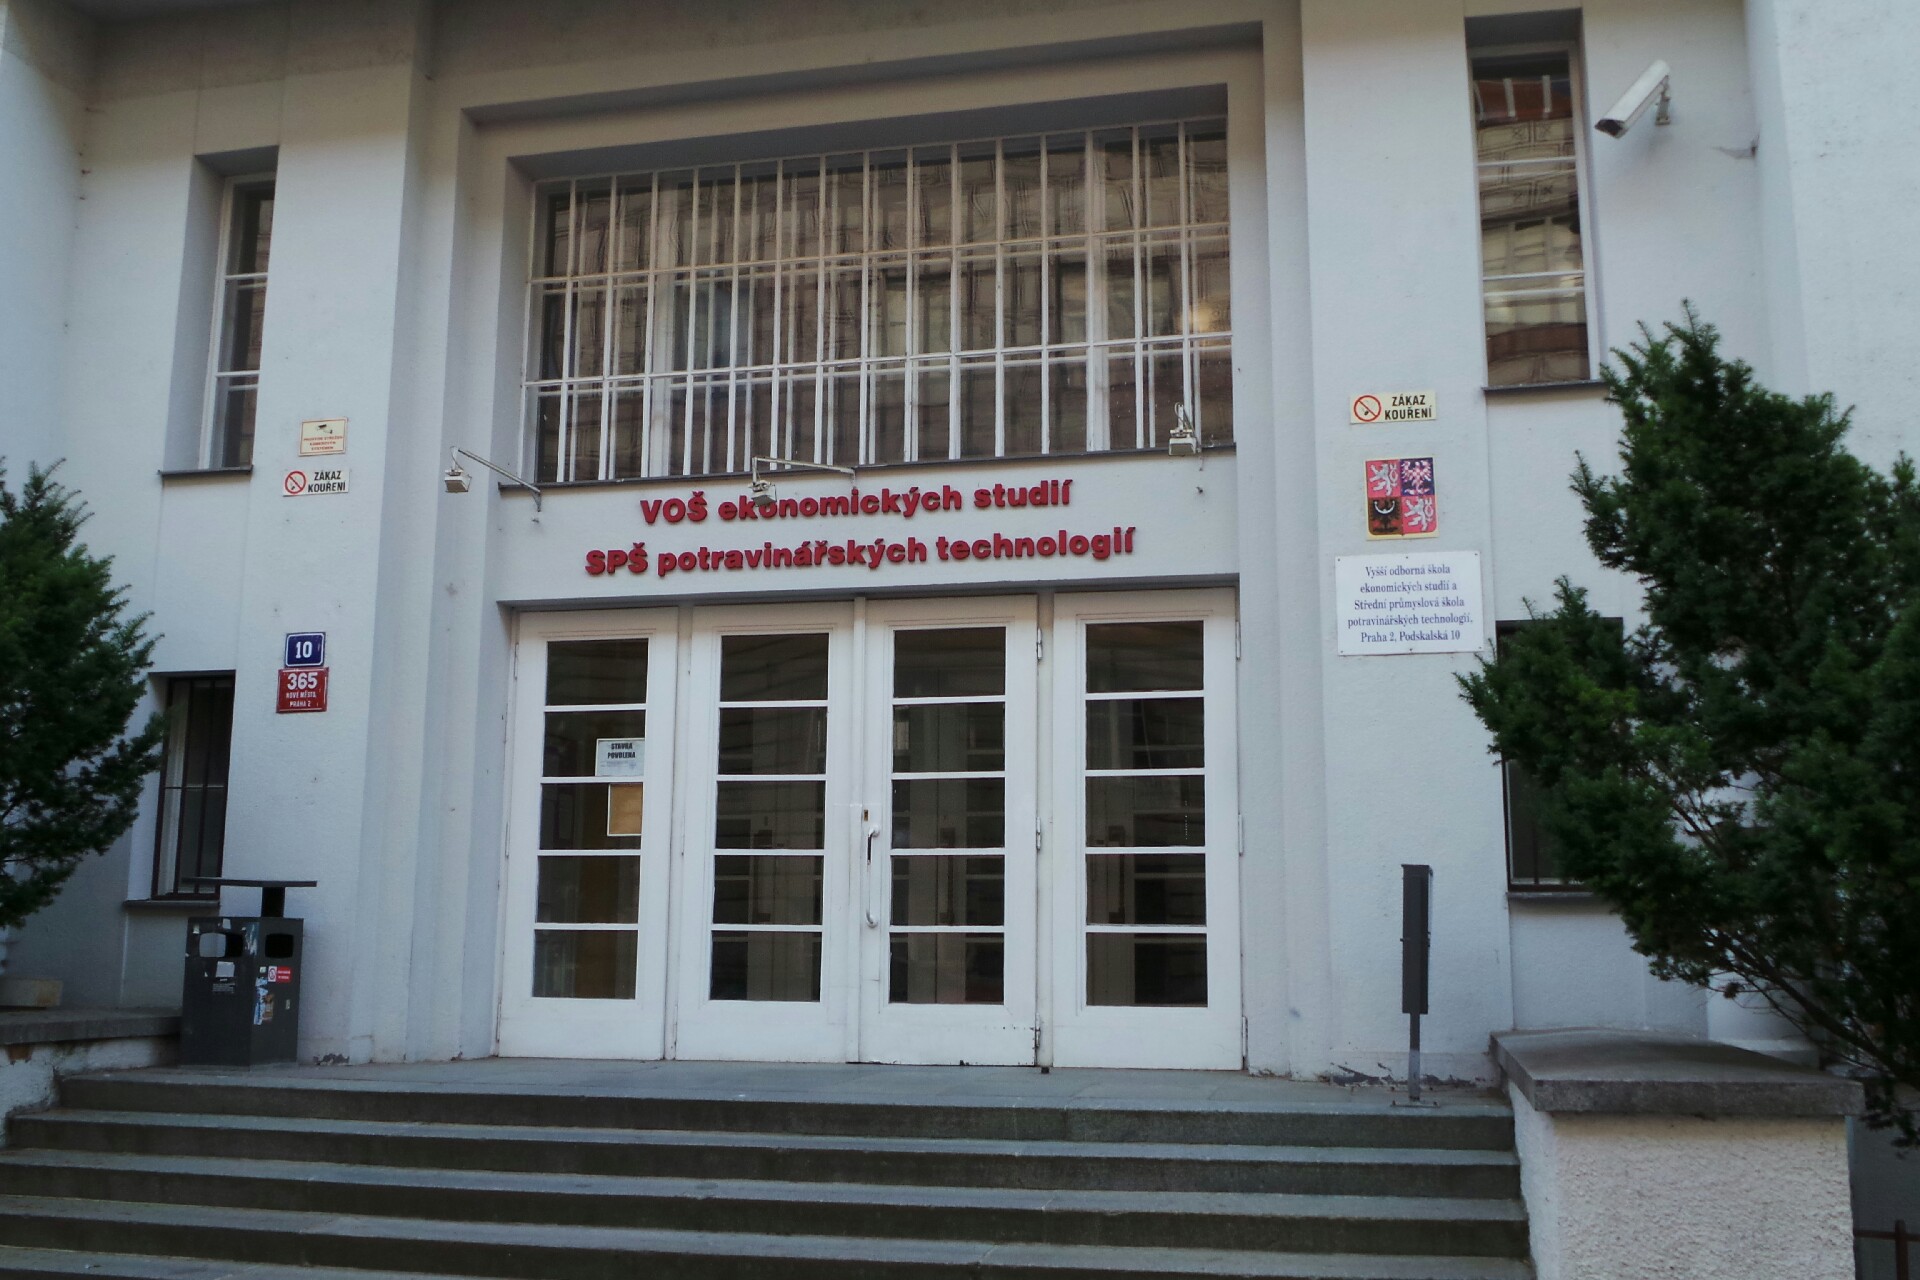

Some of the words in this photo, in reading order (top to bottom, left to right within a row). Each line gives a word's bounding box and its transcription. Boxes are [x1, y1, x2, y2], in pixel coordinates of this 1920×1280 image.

[1392, 393, 1425, 406] ZÁKAZ
[1384, 405, 1432, 420] KOUŘENÍ
[314, 469, 342, 481] ZÁKAZ
[308, 481, 346, 493] KOUŘENÍ
[640, 491, 708, 525] VOŠ
[718, 485, 962, 523] ekonomických
[973, 479, 1073, 509] studií
[584, 542, 648, 576] SPŠ
[657, 537, 926, 577] potravinářských
[936, 526, 1136, 561] technologií
[1365, 565, 1387, 579] Vyšší
[1390, 565, 1426, 576] odborná
[1428, 564, 1451, 575] škola
[1360, 581, 1422, 594] ekonomických
[1424, 580, 1450, 591] studií
[1354, 598, 1387, 610] Střední
[1389, 597, 1440, 612] průmyslová
[1441, 596, 1465, 607] škola
[1348, 614, 1419, 629] potravinářských
[1361, 632, 1387, 643] Praha
[1400, 630, 1448, 642] Podskalská
[1451, 630, 1460, 640] 10
[296, 641, 313, 659] 10
[287, 672, 318, 690] 365
[289, 700, 306, 708] PRAHA
